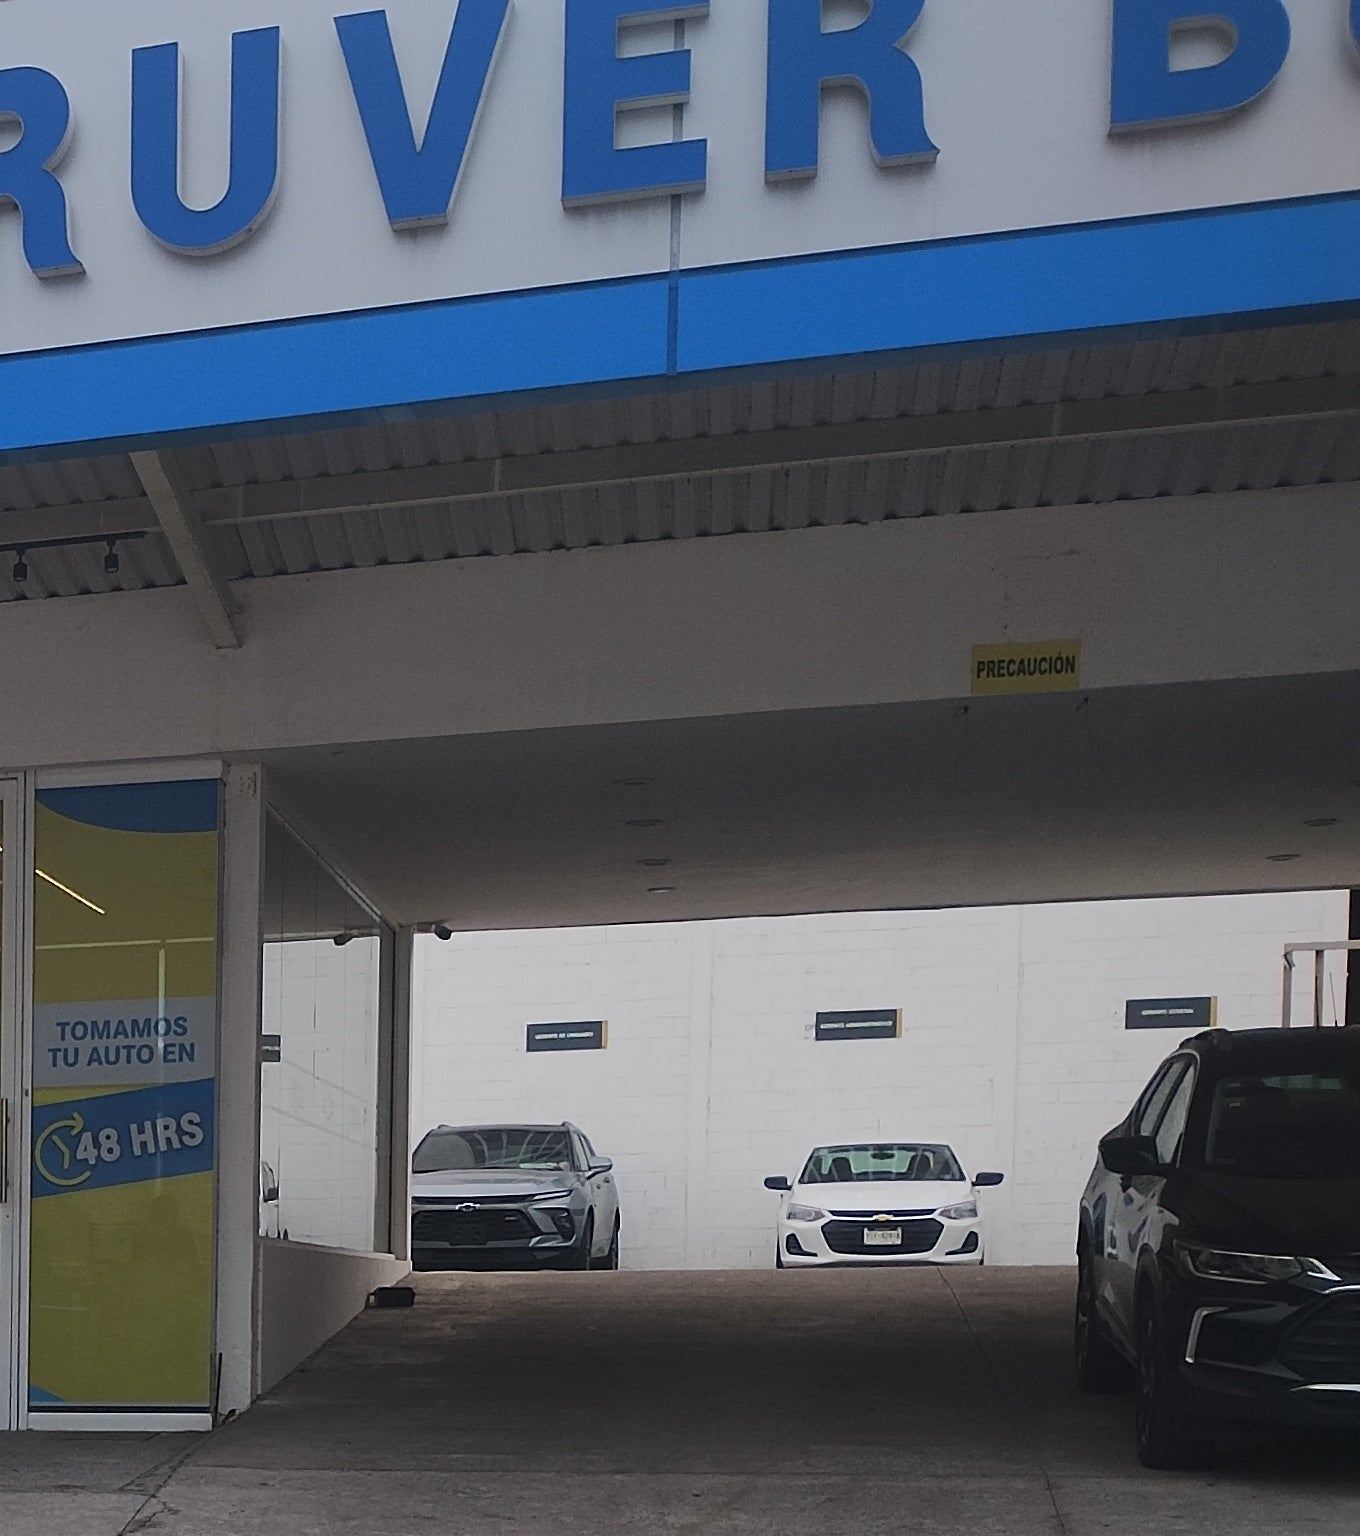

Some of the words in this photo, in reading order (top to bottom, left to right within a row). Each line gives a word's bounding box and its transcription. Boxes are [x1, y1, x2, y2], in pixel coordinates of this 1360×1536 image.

[976, 650, 1076, 679] PRECAUCIÓN
[56, 1016, 188, 1042] TOMAMOS
[48, 1047, 79, 1068] TU
[86, 1043, 155, 1066] AUTO
[162, 1042, 195, 1064] EN
[76, 1127, 121, 1165] 48
[129, 1111, 204, 1157] HRS
